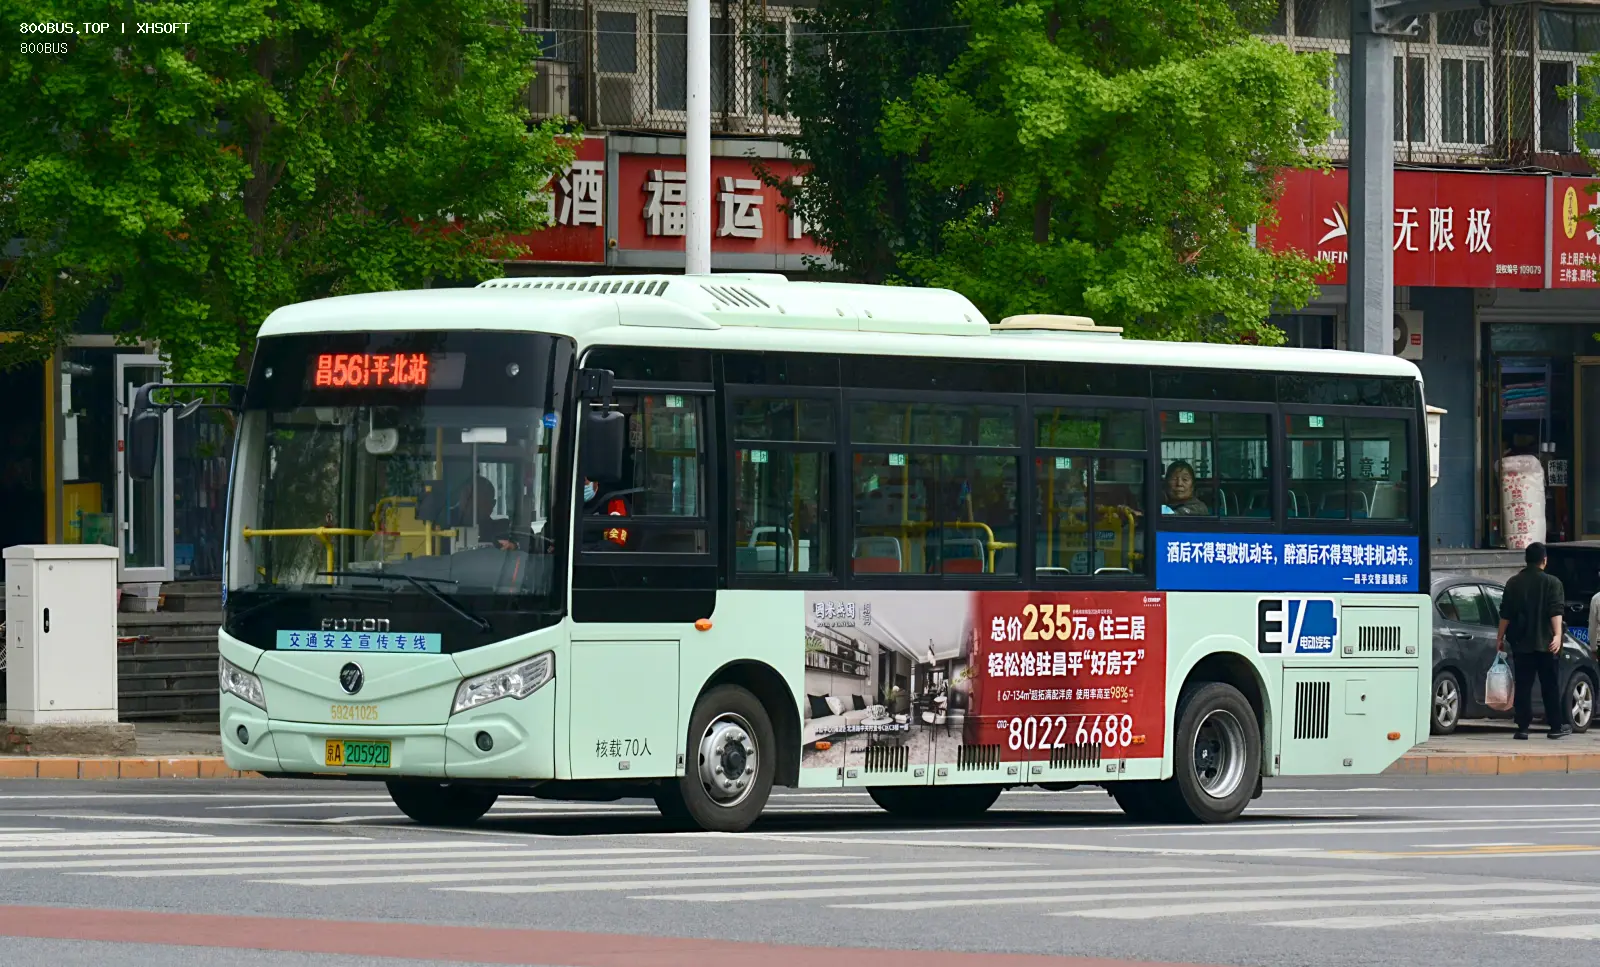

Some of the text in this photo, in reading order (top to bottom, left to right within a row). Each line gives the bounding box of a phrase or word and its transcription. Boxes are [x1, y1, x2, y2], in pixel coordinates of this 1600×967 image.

[1392, 206, 1493, 253] 无限极
[1317, 250, 1348, 264] INFIN
[1099, 616, 1146, 641] 住三居
[289, 632, 427, 650] 交通安全宣传专线
[1300, 636, 1331, 649] 电动汽车
[331, 705, 379, 720] 59241025
[595, 737, 652, 758] 核载70人
